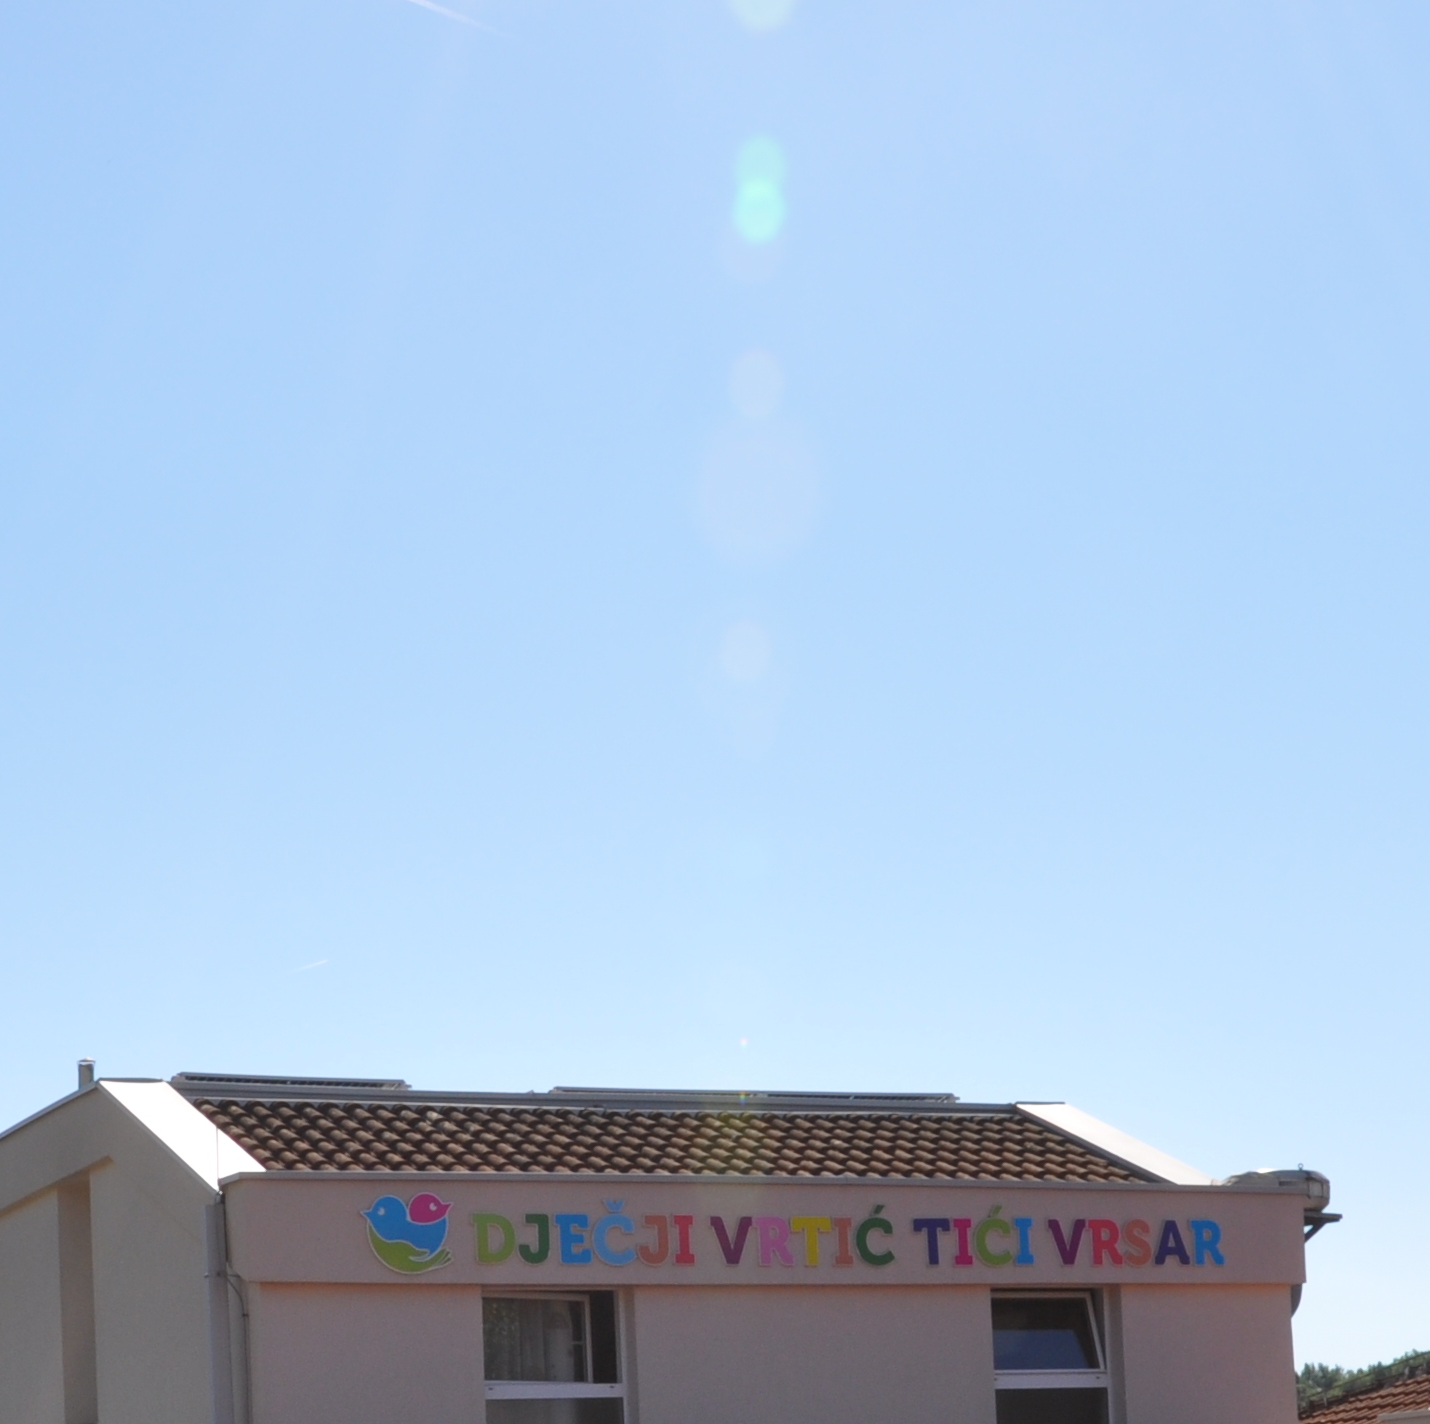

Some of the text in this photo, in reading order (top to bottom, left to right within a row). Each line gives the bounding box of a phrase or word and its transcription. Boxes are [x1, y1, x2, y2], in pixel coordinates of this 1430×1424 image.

[469, 1199, 1225, 1267] DJEČJI VRTIĆ TIĆI VRSAR
